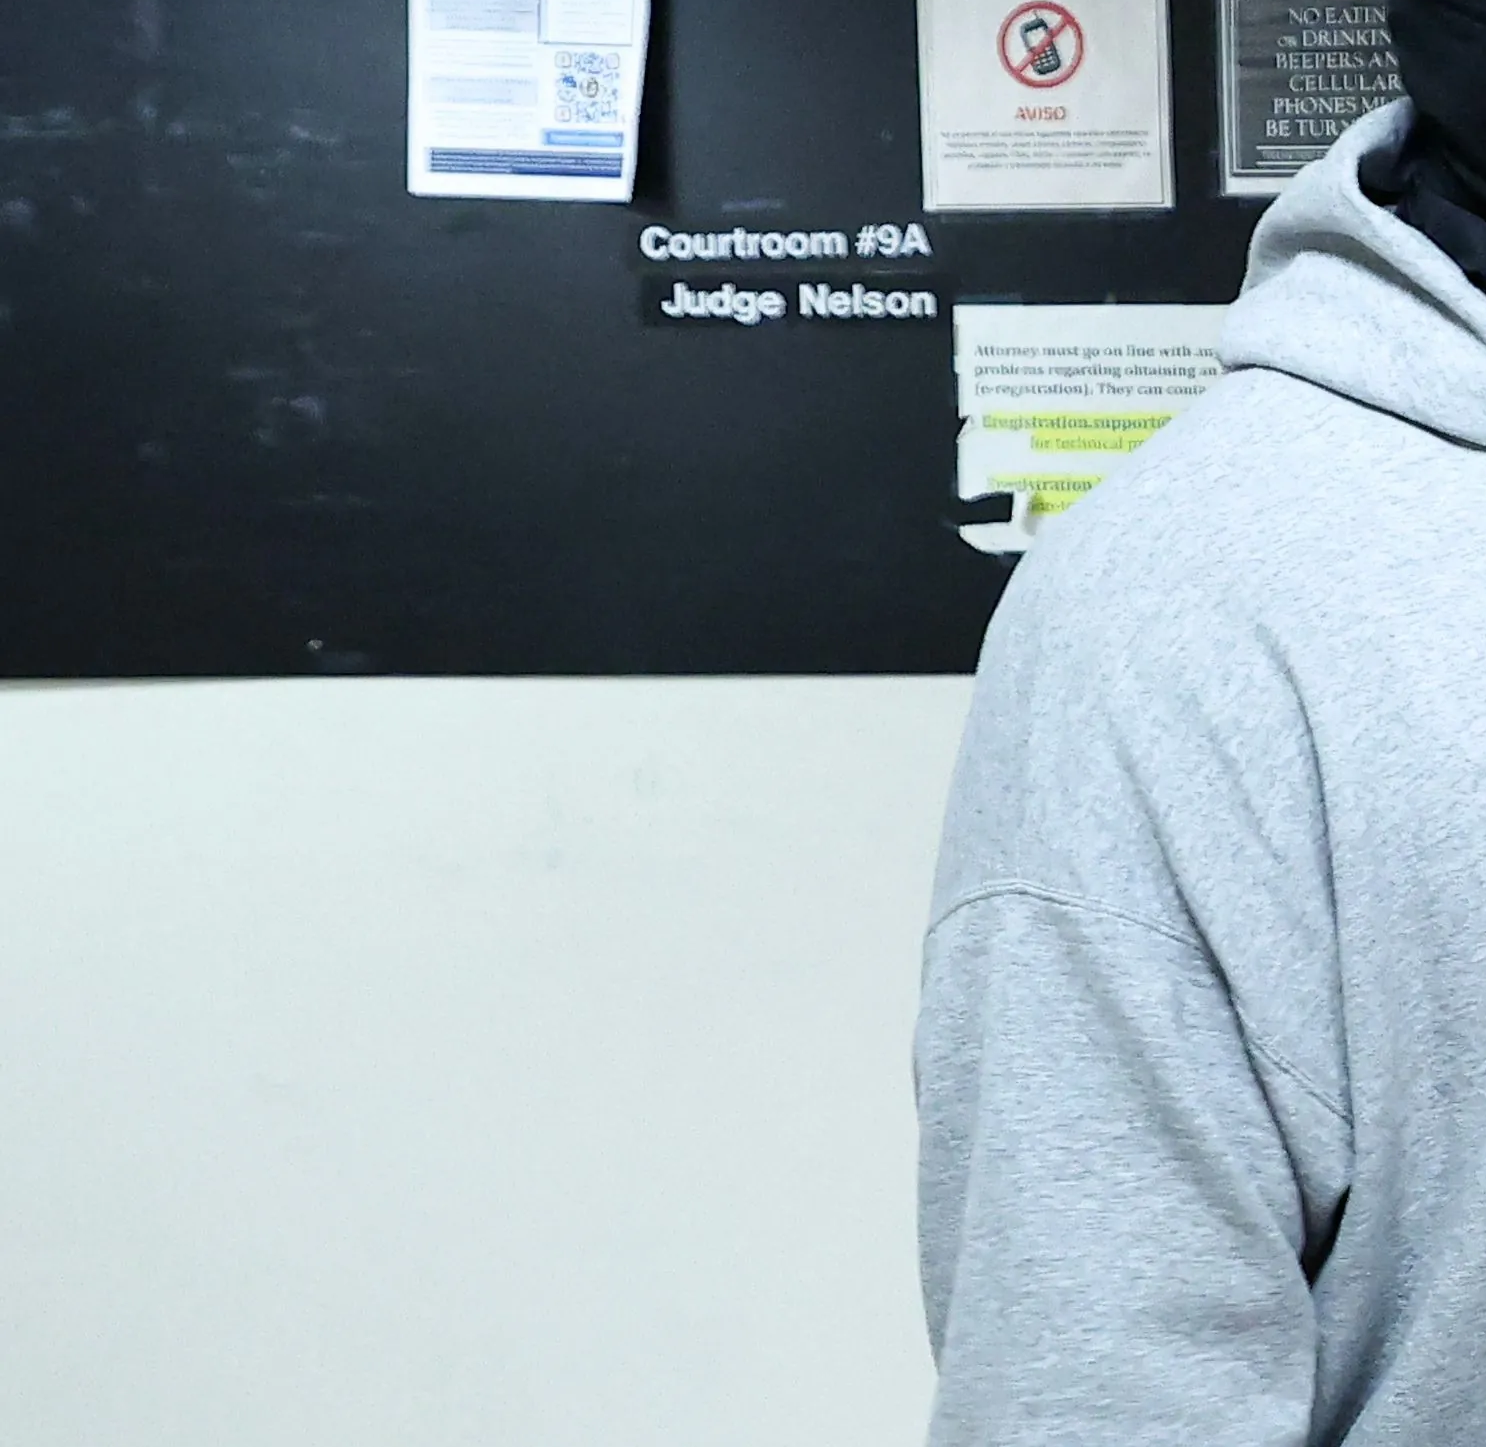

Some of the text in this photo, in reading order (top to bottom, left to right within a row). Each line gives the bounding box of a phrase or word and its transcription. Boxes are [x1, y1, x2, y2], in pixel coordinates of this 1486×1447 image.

[1288, 7, 1319, 25] NO
[1016, 106, 1066, 121] AVISO
[1273, 96, 1356, 114] PHONES
[641, 224, 931, 259] Courtroom #9A
[662, 283, 936, 324] Judge Nelson
